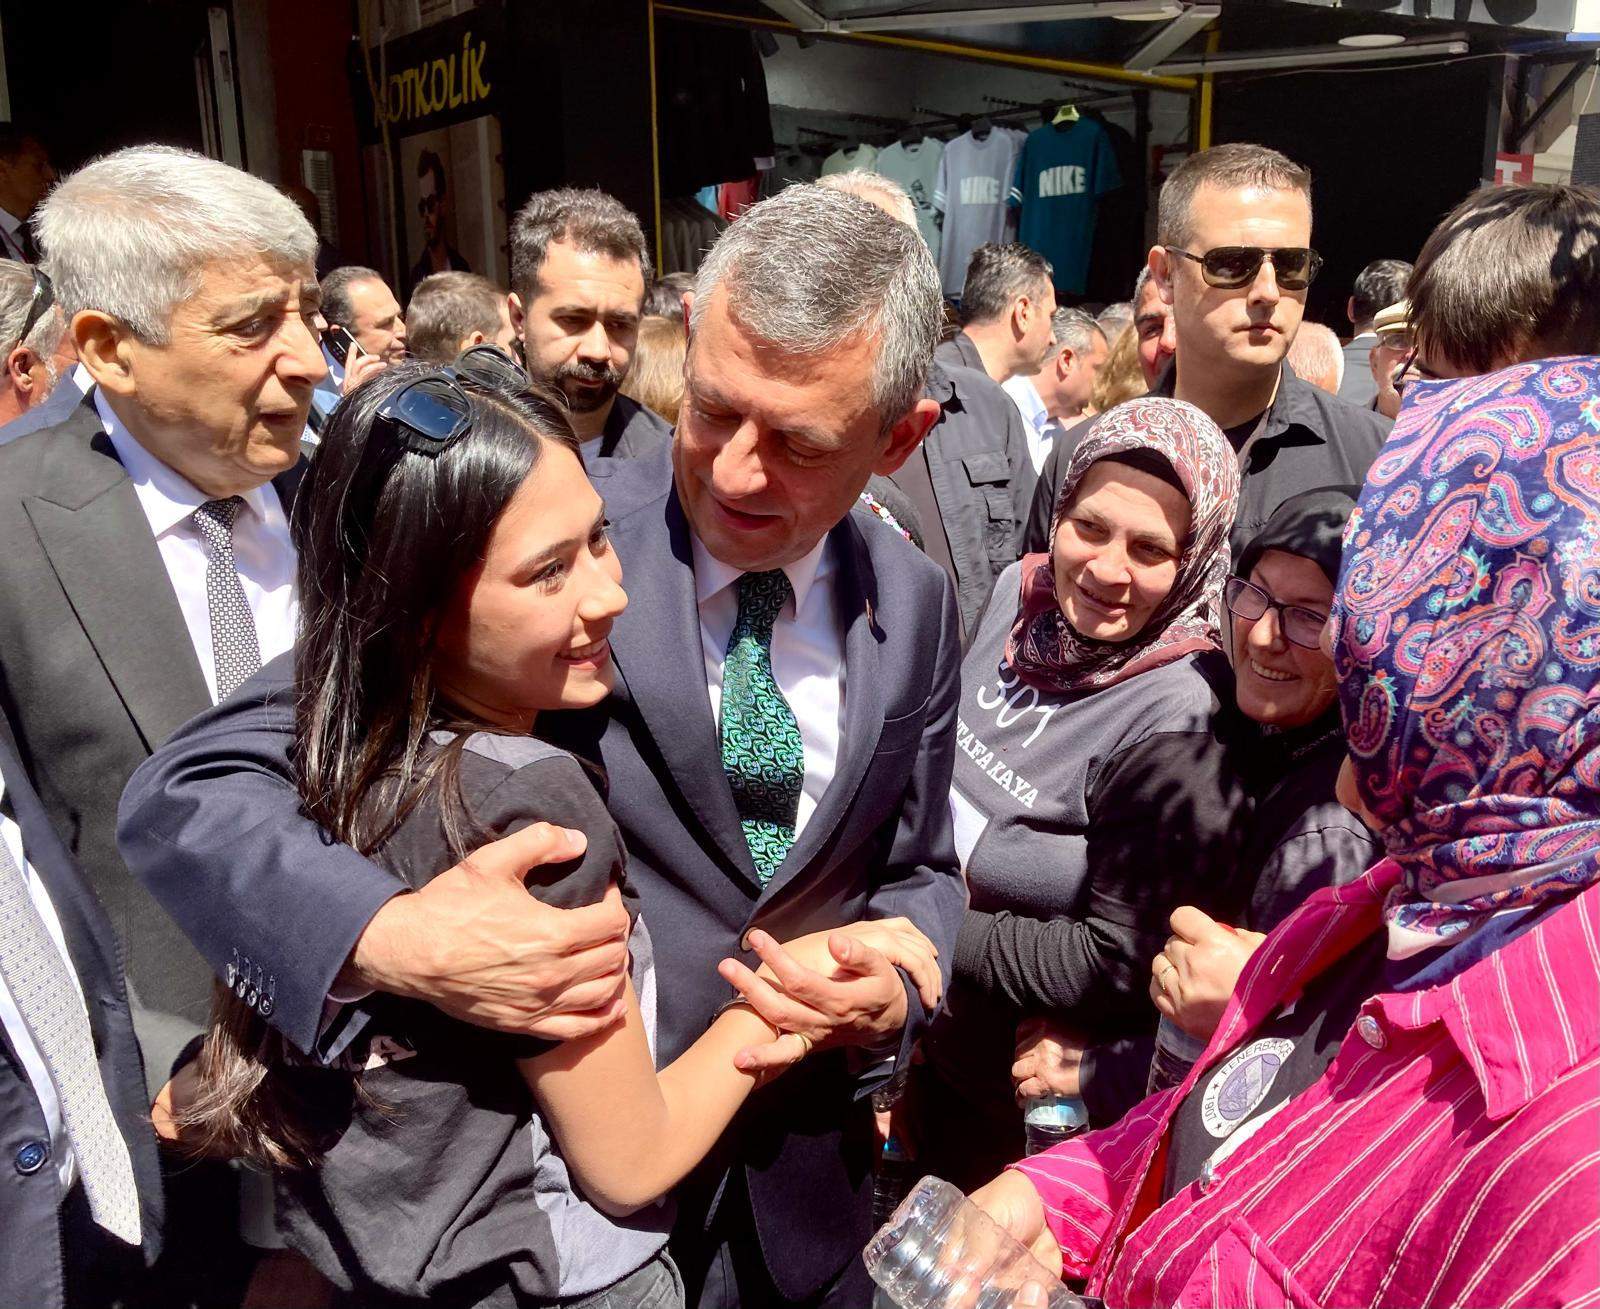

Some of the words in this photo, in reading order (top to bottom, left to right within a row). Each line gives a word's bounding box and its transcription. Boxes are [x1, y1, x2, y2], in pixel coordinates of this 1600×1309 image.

[960, 175, 1000, 205] NIKE
[1038, 164, 1087, 199] NIKE
[976, 661, 1061, 749] 301
[956, 714, 995, 771] TAFA
[985, 760, 1039, 809] KAYA
[1204, 1094, 1218, 1122] 1907
